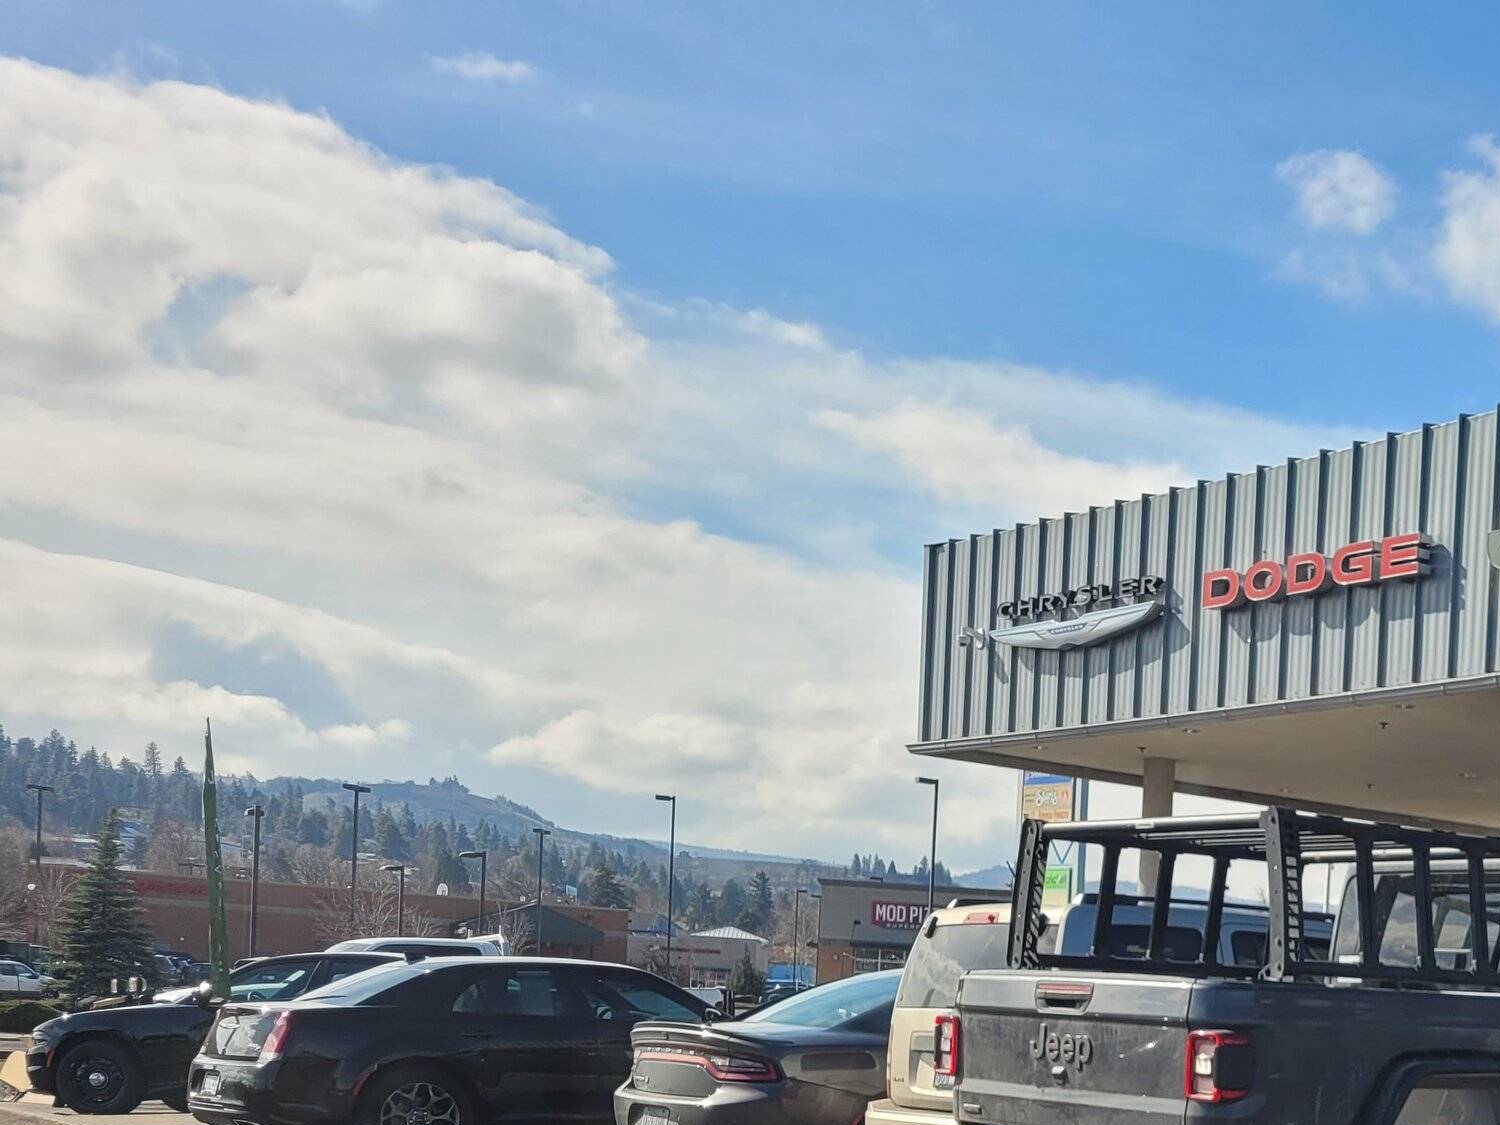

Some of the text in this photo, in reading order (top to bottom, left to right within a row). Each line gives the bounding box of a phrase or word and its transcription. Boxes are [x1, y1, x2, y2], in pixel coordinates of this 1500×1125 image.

[1202, 533, 1425, 609] DODGE
[998, 575, 1165, 620] CHRYSLER
[875, 903, 931, 924] MOD PIZ
[1029, 1023, 1093, 1073] Jeep
